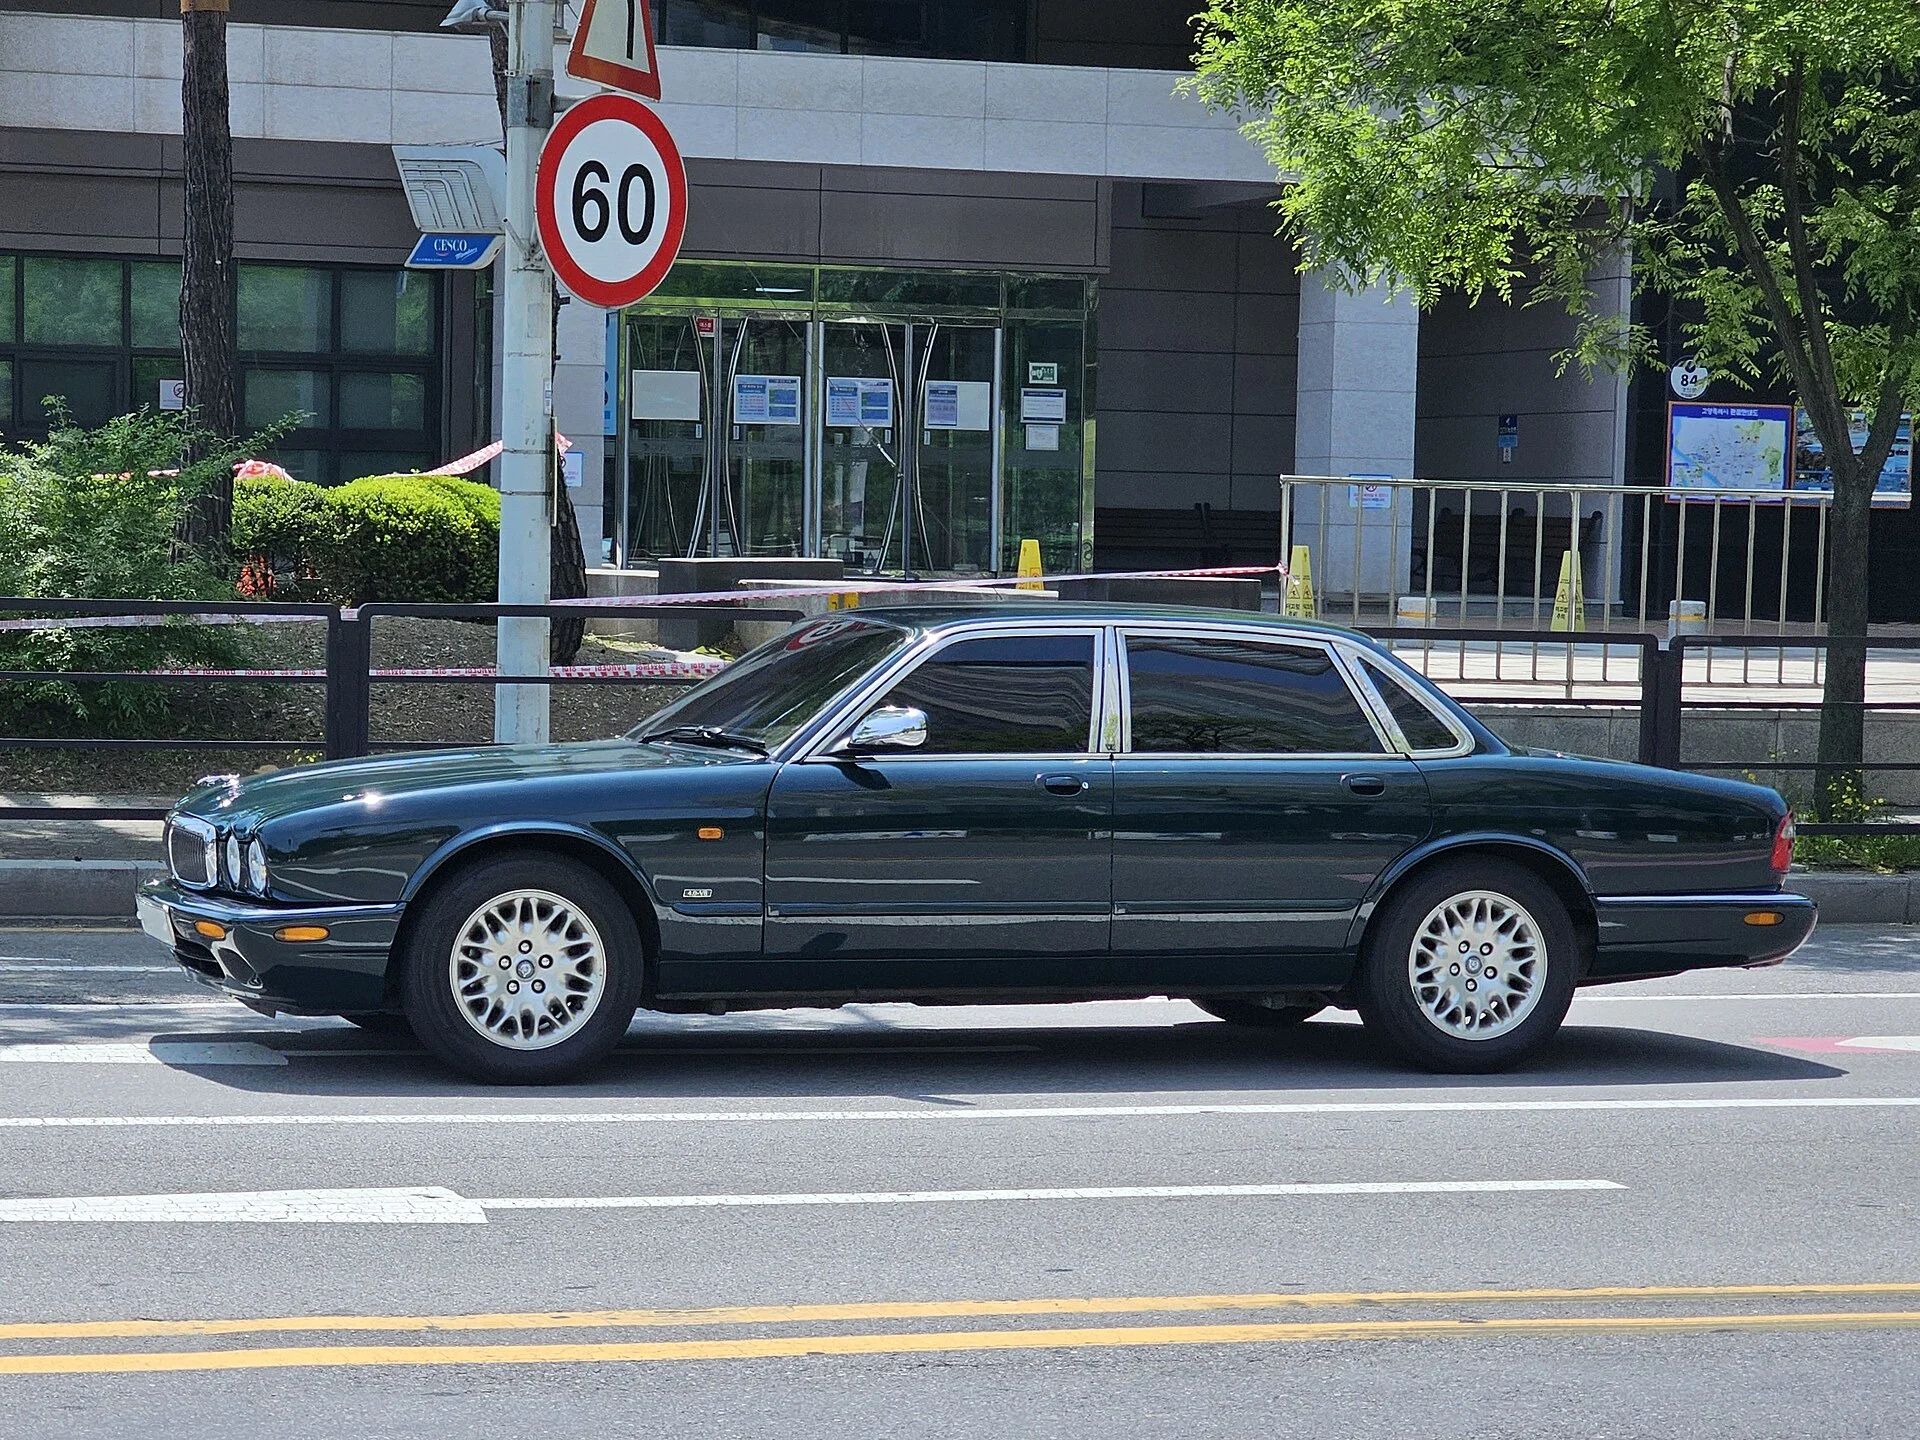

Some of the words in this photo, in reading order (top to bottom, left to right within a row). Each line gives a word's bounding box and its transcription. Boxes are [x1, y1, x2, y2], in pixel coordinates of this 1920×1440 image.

[572, 160, 655, 245] 60
[434, 239, 467, 252] CESCO
[1681, 374, 1698, 387] 84
